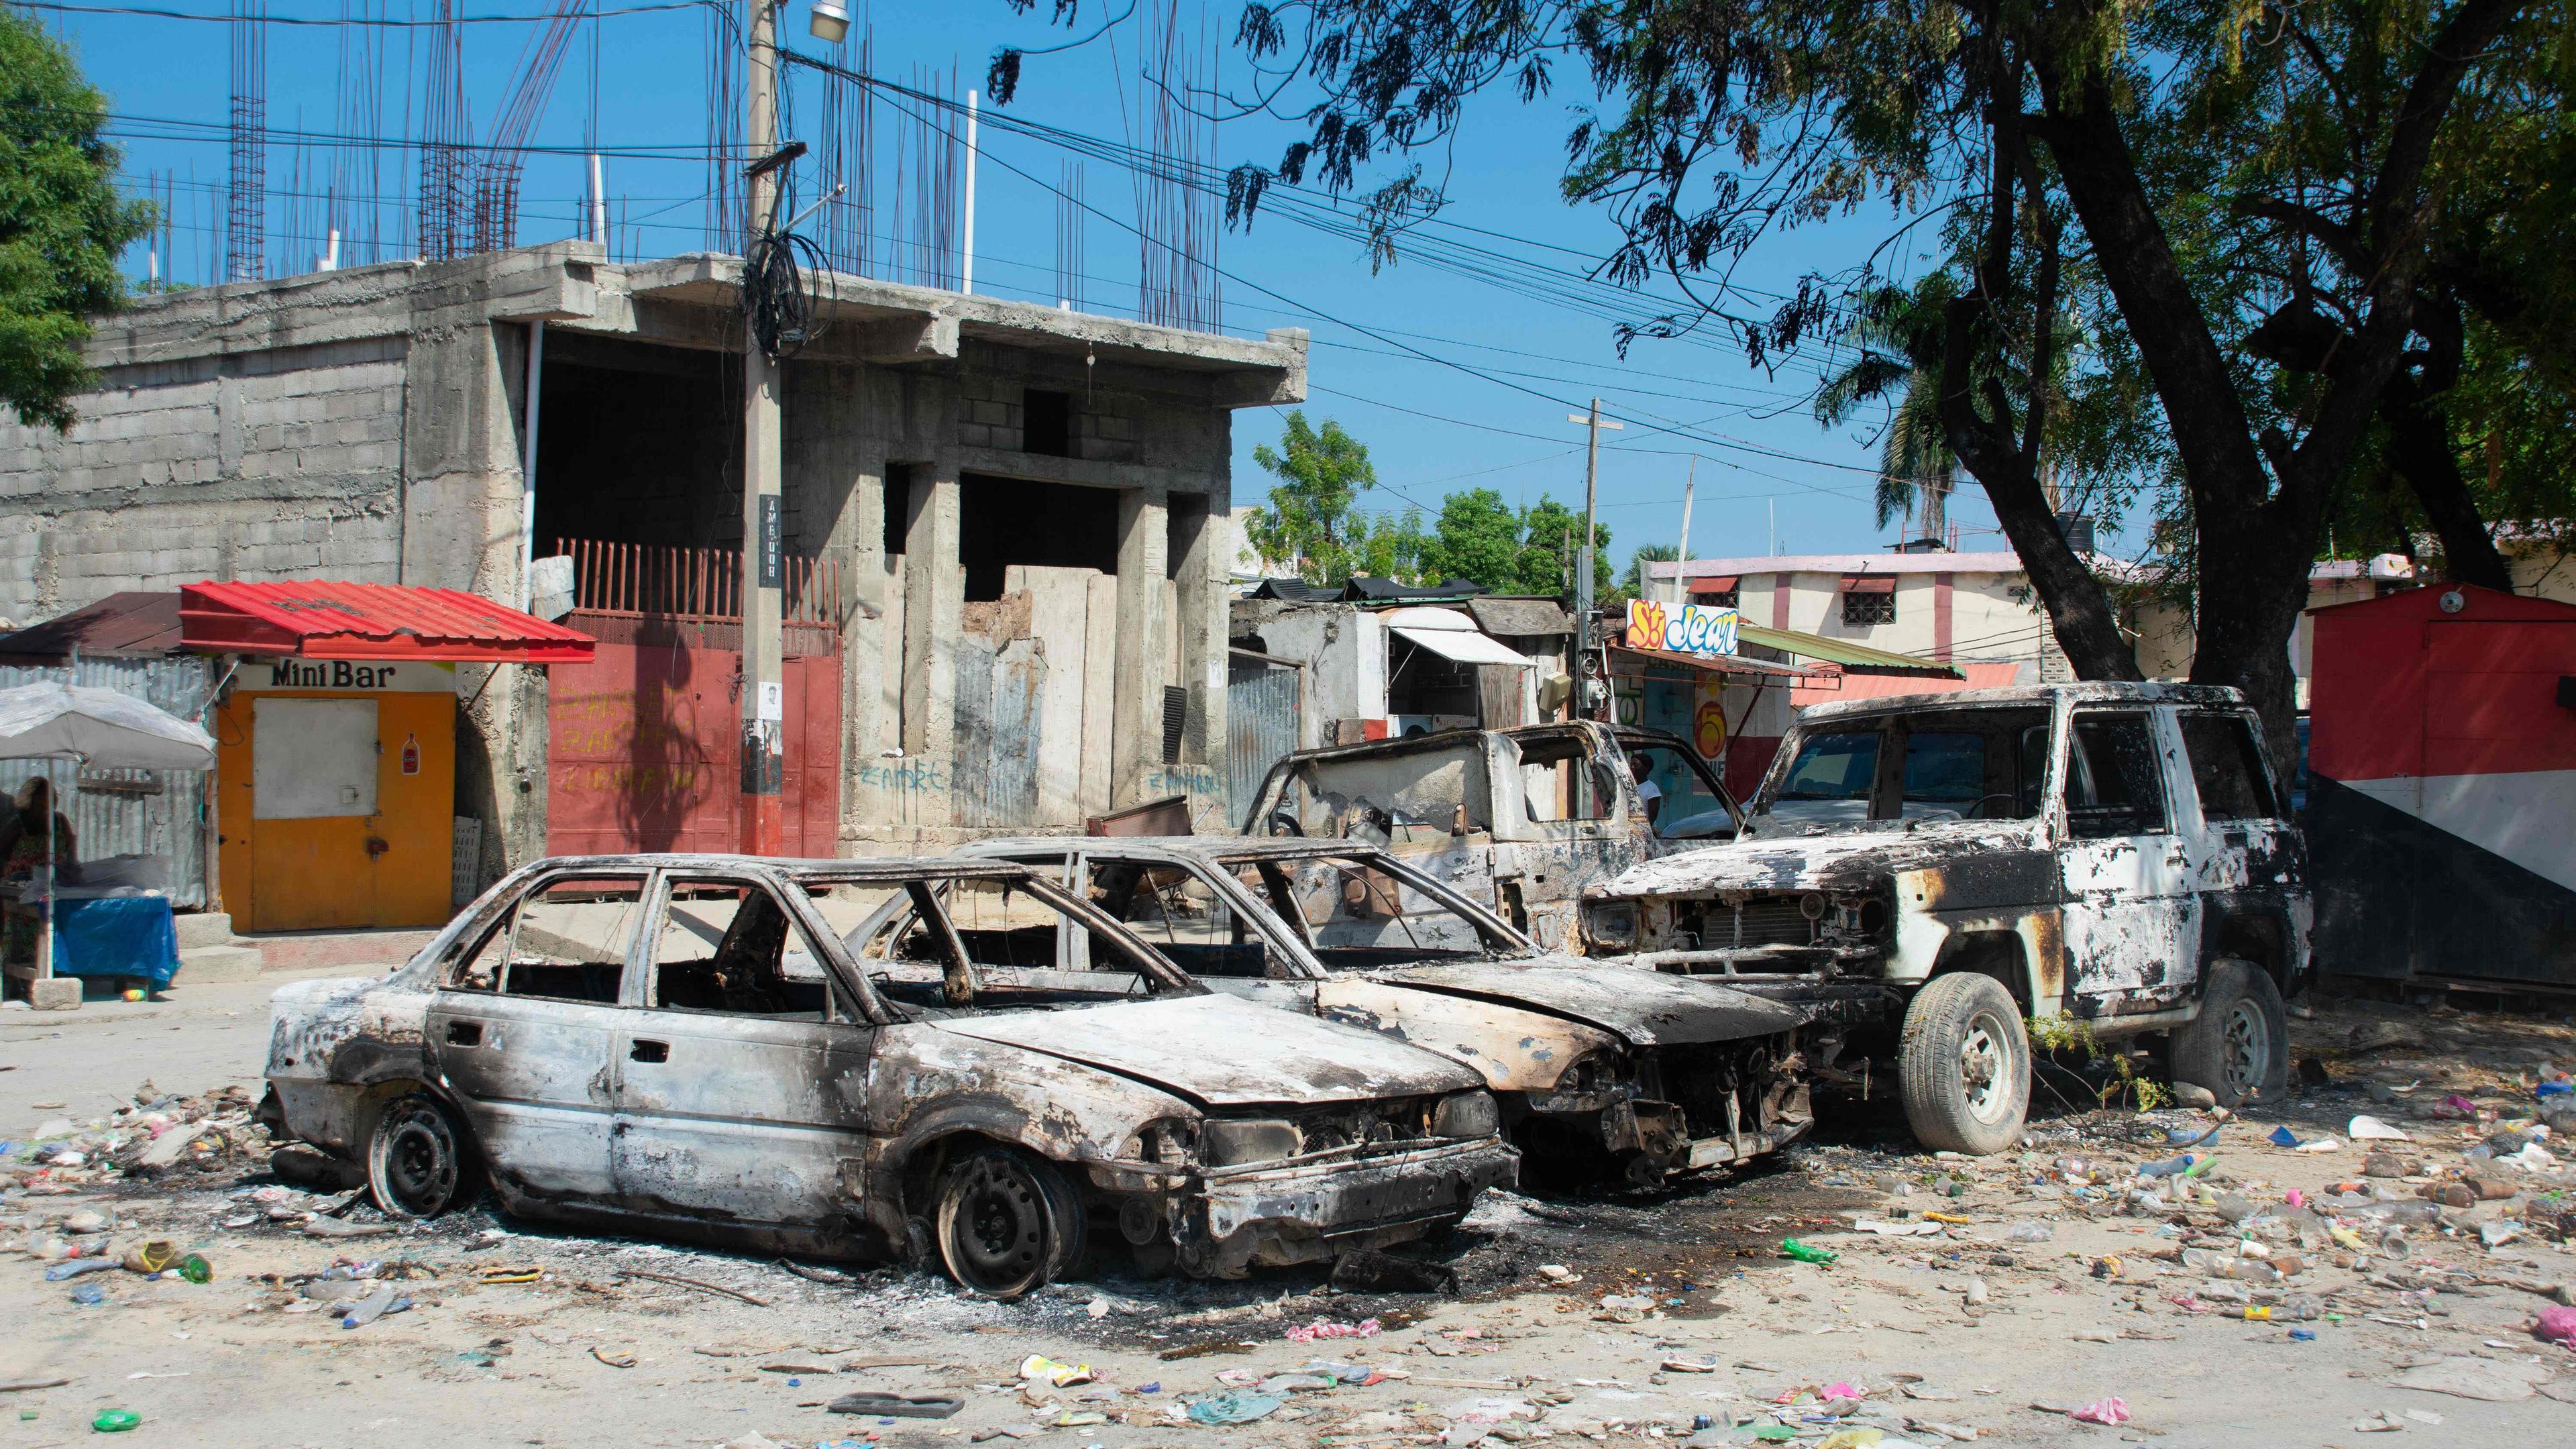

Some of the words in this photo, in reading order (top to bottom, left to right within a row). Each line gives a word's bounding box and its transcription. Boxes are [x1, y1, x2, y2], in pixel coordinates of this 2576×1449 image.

[1666, 604, 1738, 654] Jean
[272, 659, 327, 688] Mini
[332, 661, 396, 688] Bar
[1700, 707, 1725, 757] 5
